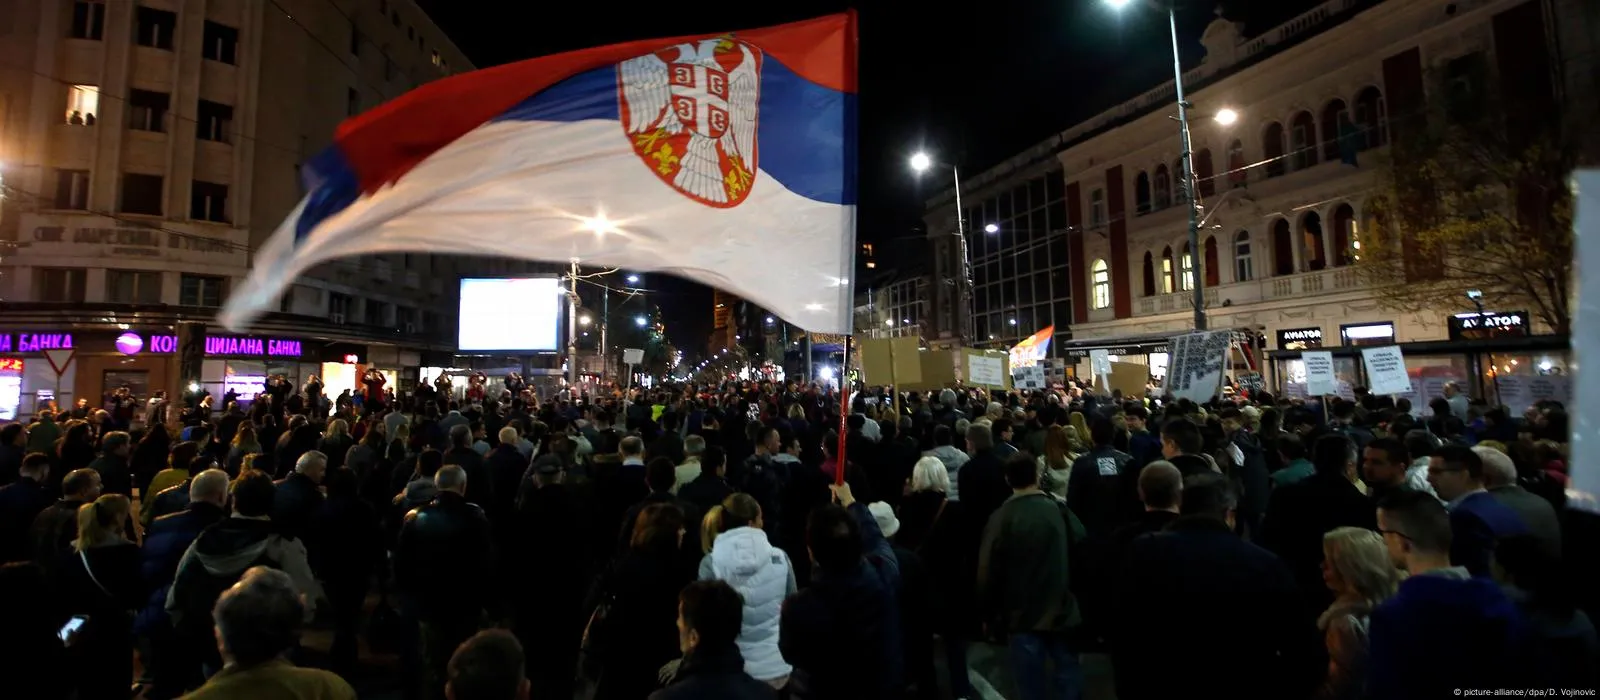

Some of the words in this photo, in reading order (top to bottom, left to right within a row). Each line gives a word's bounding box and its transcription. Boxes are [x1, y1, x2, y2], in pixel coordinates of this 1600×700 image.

[1463, 315, 1521, 328] AVATOR
[1284, 329, 1321, 340] AVIATOR
[19, 334, 73, 352] БАНКА
[268, 339, 301, 355] БАНКА
